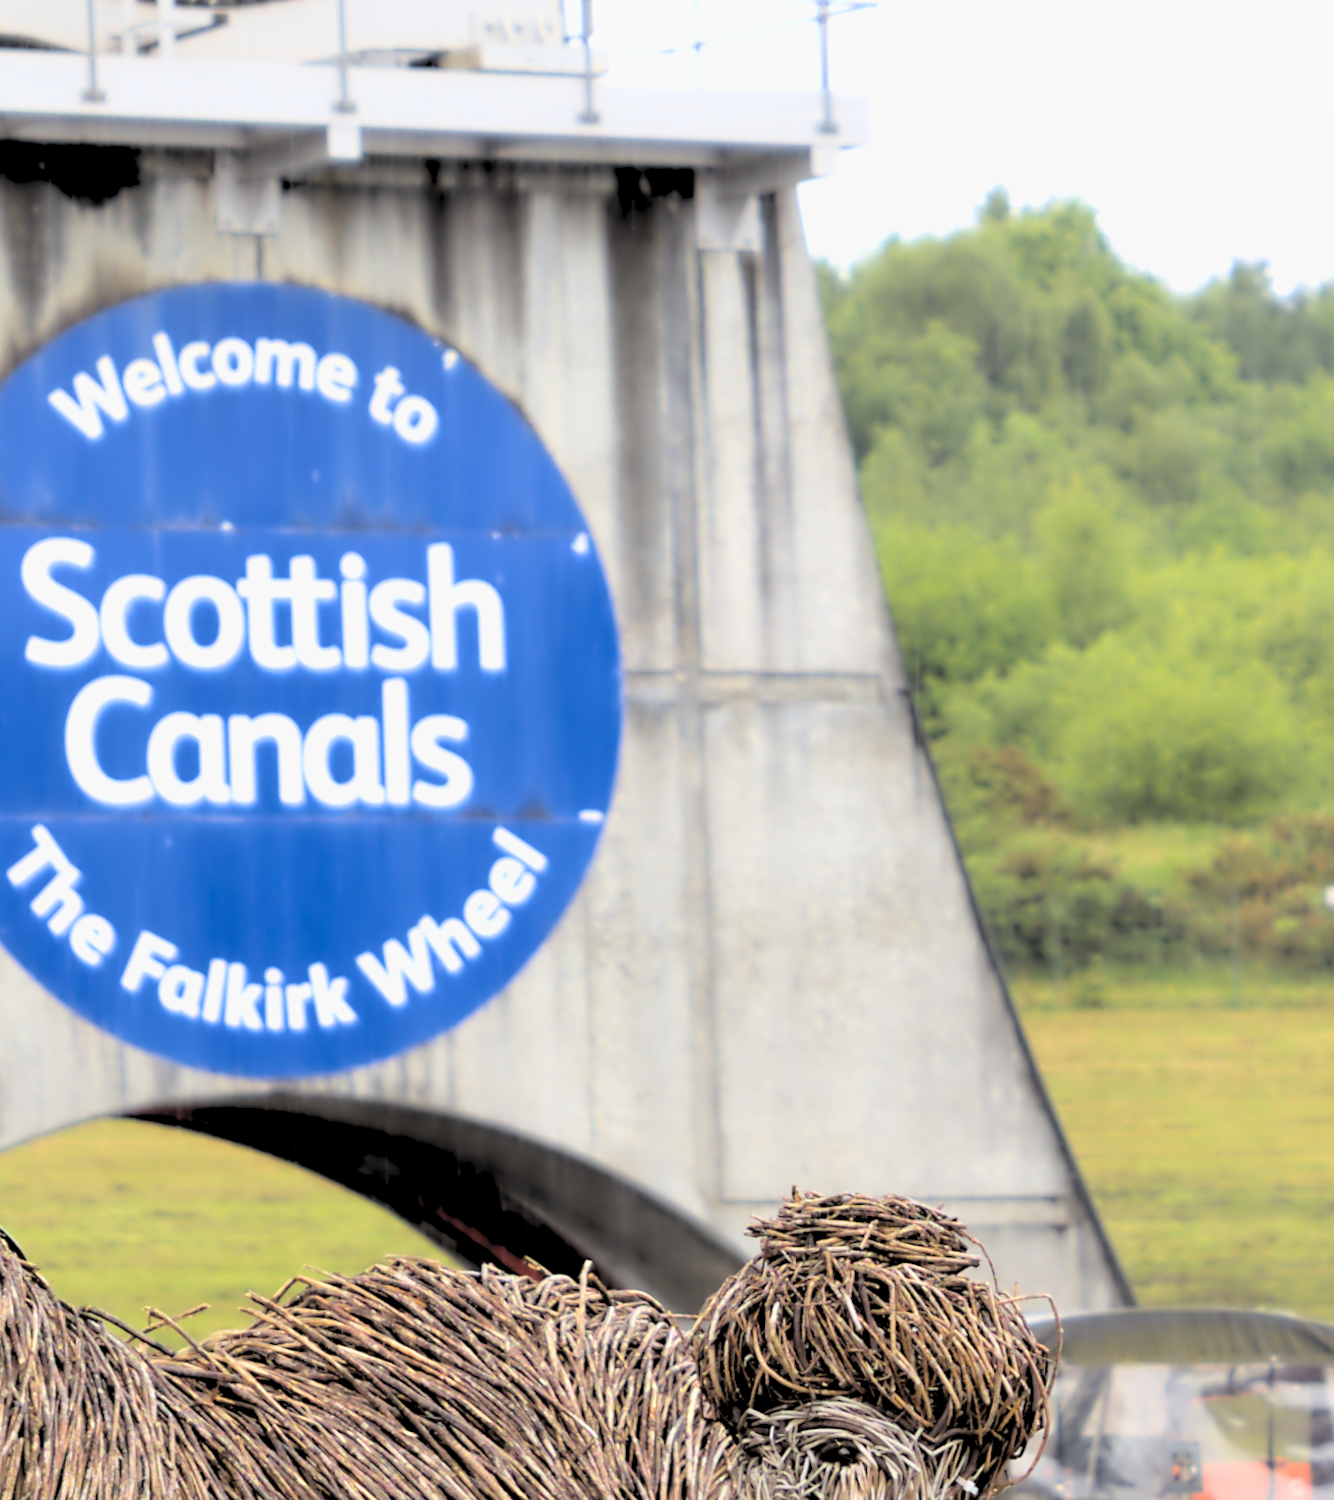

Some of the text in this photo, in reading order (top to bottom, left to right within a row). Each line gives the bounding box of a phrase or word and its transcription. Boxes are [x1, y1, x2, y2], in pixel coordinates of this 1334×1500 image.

[46, 331, 440, 446] Welcome to
[19, 536, 507, 671] Scottish
[64, 675, 474, 808] Canals
[6, 823, 551, 1032] The Falkirk Wheel
